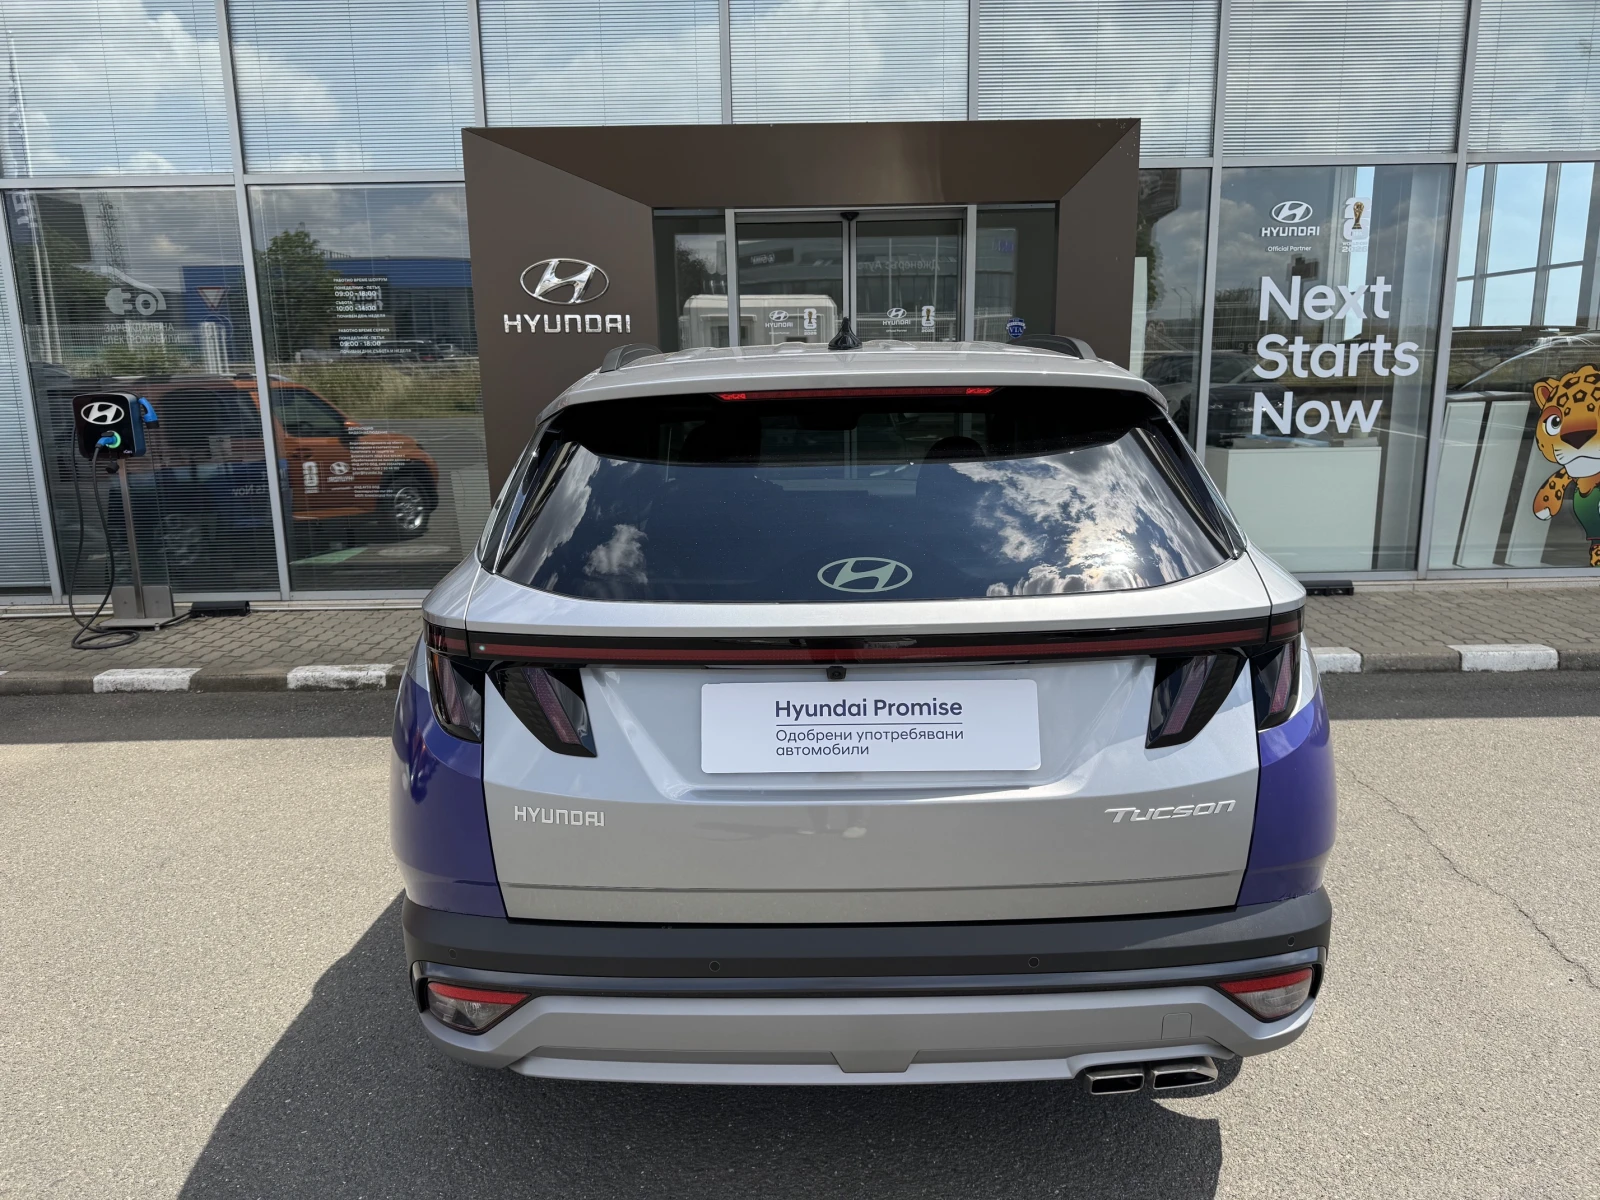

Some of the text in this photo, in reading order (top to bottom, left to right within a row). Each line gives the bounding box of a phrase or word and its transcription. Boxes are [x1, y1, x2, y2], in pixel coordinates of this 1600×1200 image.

[1262, 226, 1320, 236] HYUNDAI
[1259, 276, 1392, 321] Next
[503, 314, 631, 333] HYUNDAI
[1252, 334, 1419, 379] Starts
[1252, 391, 1383, 435] Now
[775, 697, 963, 721] Hyundai Promise
[776, 728, 964, 743] Одобрени употребявани
[776, 744, 869, 756] автомобили
[514, 806, 605, 826] HYUNDAI
